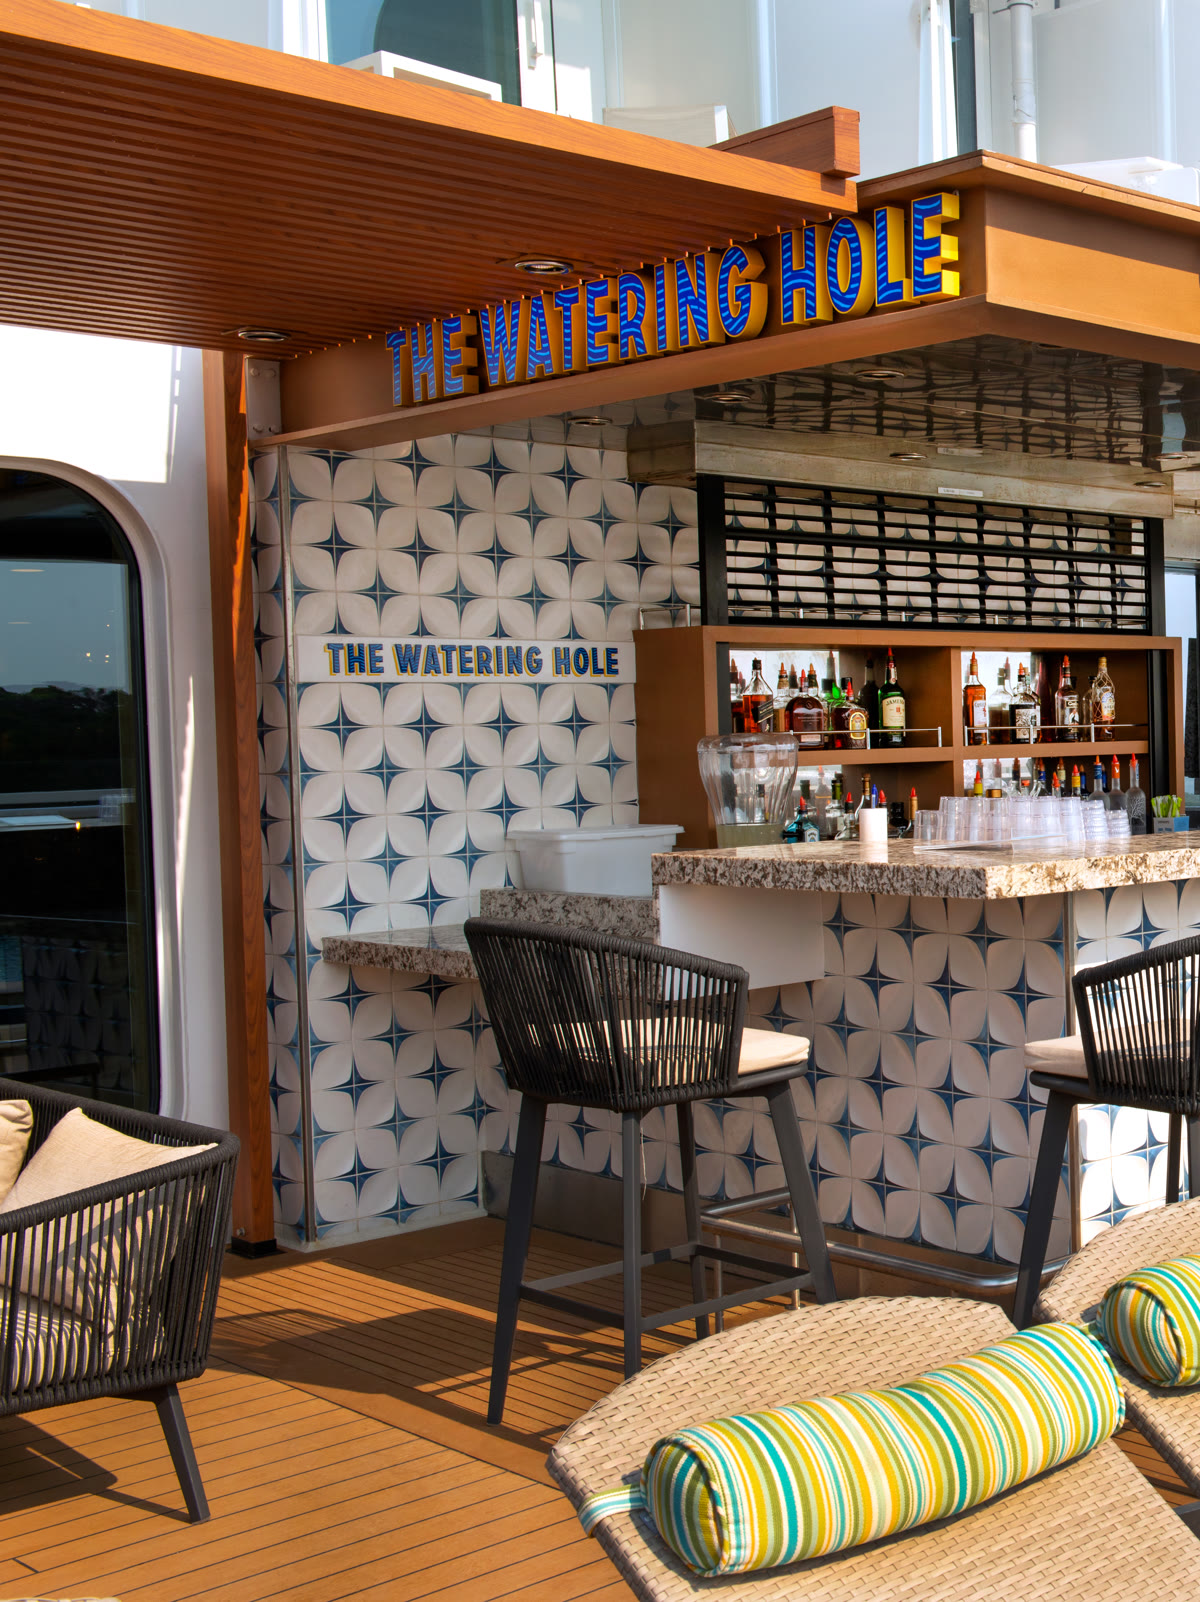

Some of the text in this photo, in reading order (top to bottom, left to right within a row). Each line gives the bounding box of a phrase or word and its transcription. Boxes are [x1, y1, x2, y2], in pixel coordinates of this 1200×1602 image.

[385, 192, 960, 406] THE WATERING HOLE
[324, 642, 619, 678] THE WATERING HOLE
